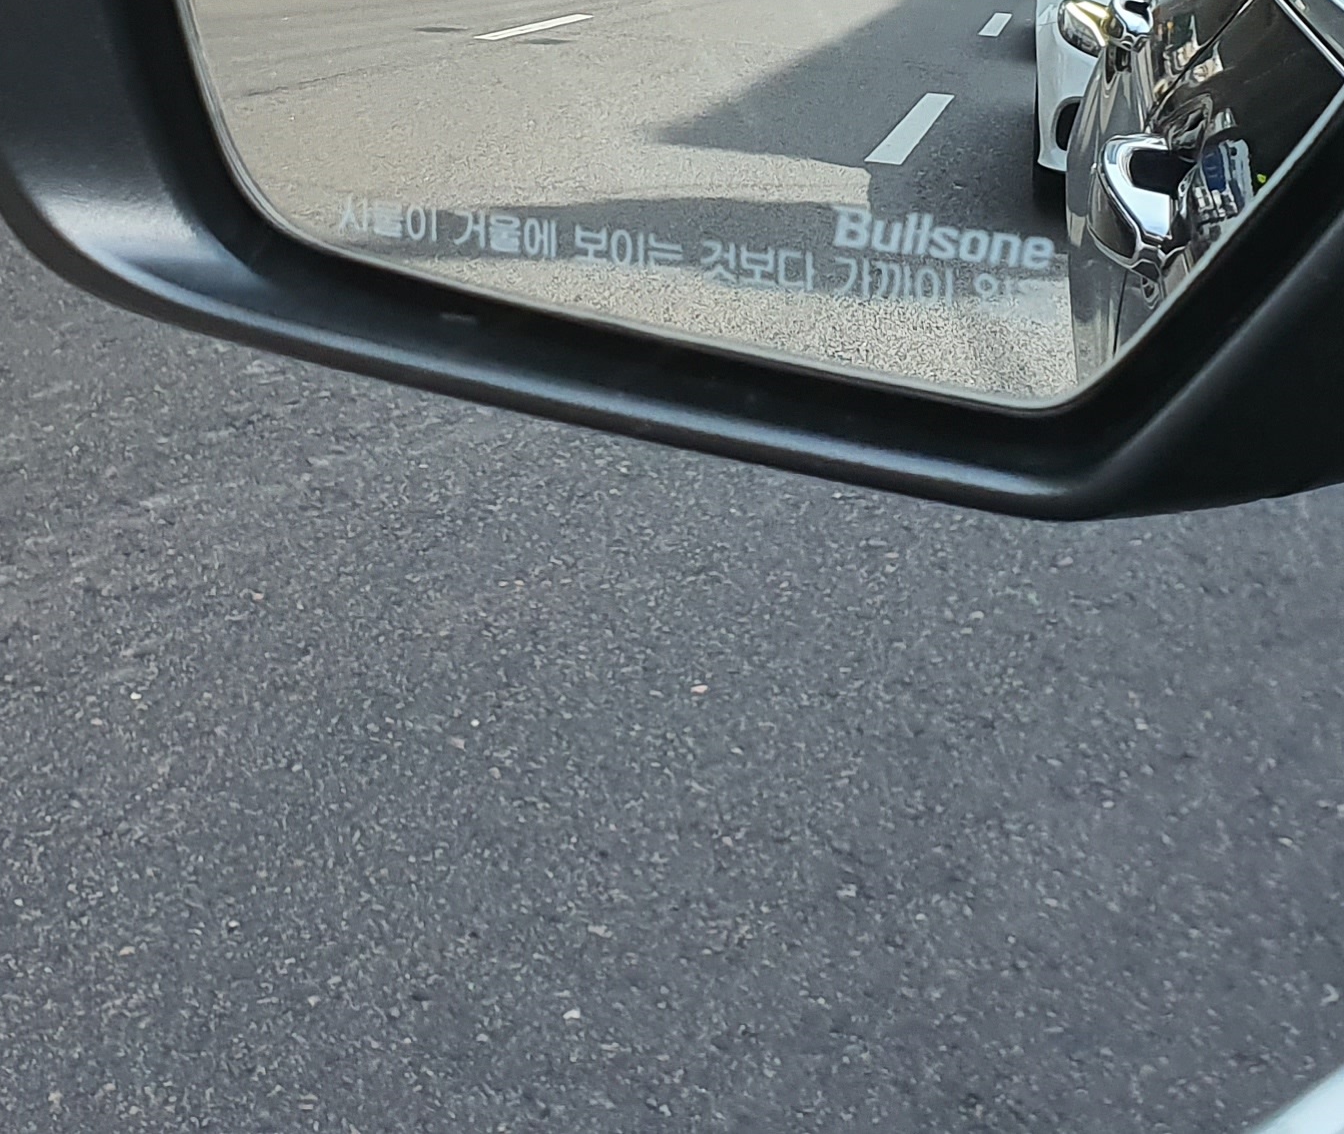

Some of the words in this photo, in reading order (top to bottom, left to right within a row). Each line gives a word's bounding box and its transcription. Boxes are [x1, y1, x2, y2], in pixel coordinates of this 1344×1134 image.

[339, 195, 437, 242] 사물이
[453, 210, 557, 259] 거울에
[574, 222, 684, 273] 보이는
[700, 239, 814, 292] 것보다
[834, 256, 953, 305] 가까이
[832, 204, 1056, 271] Bullsone
